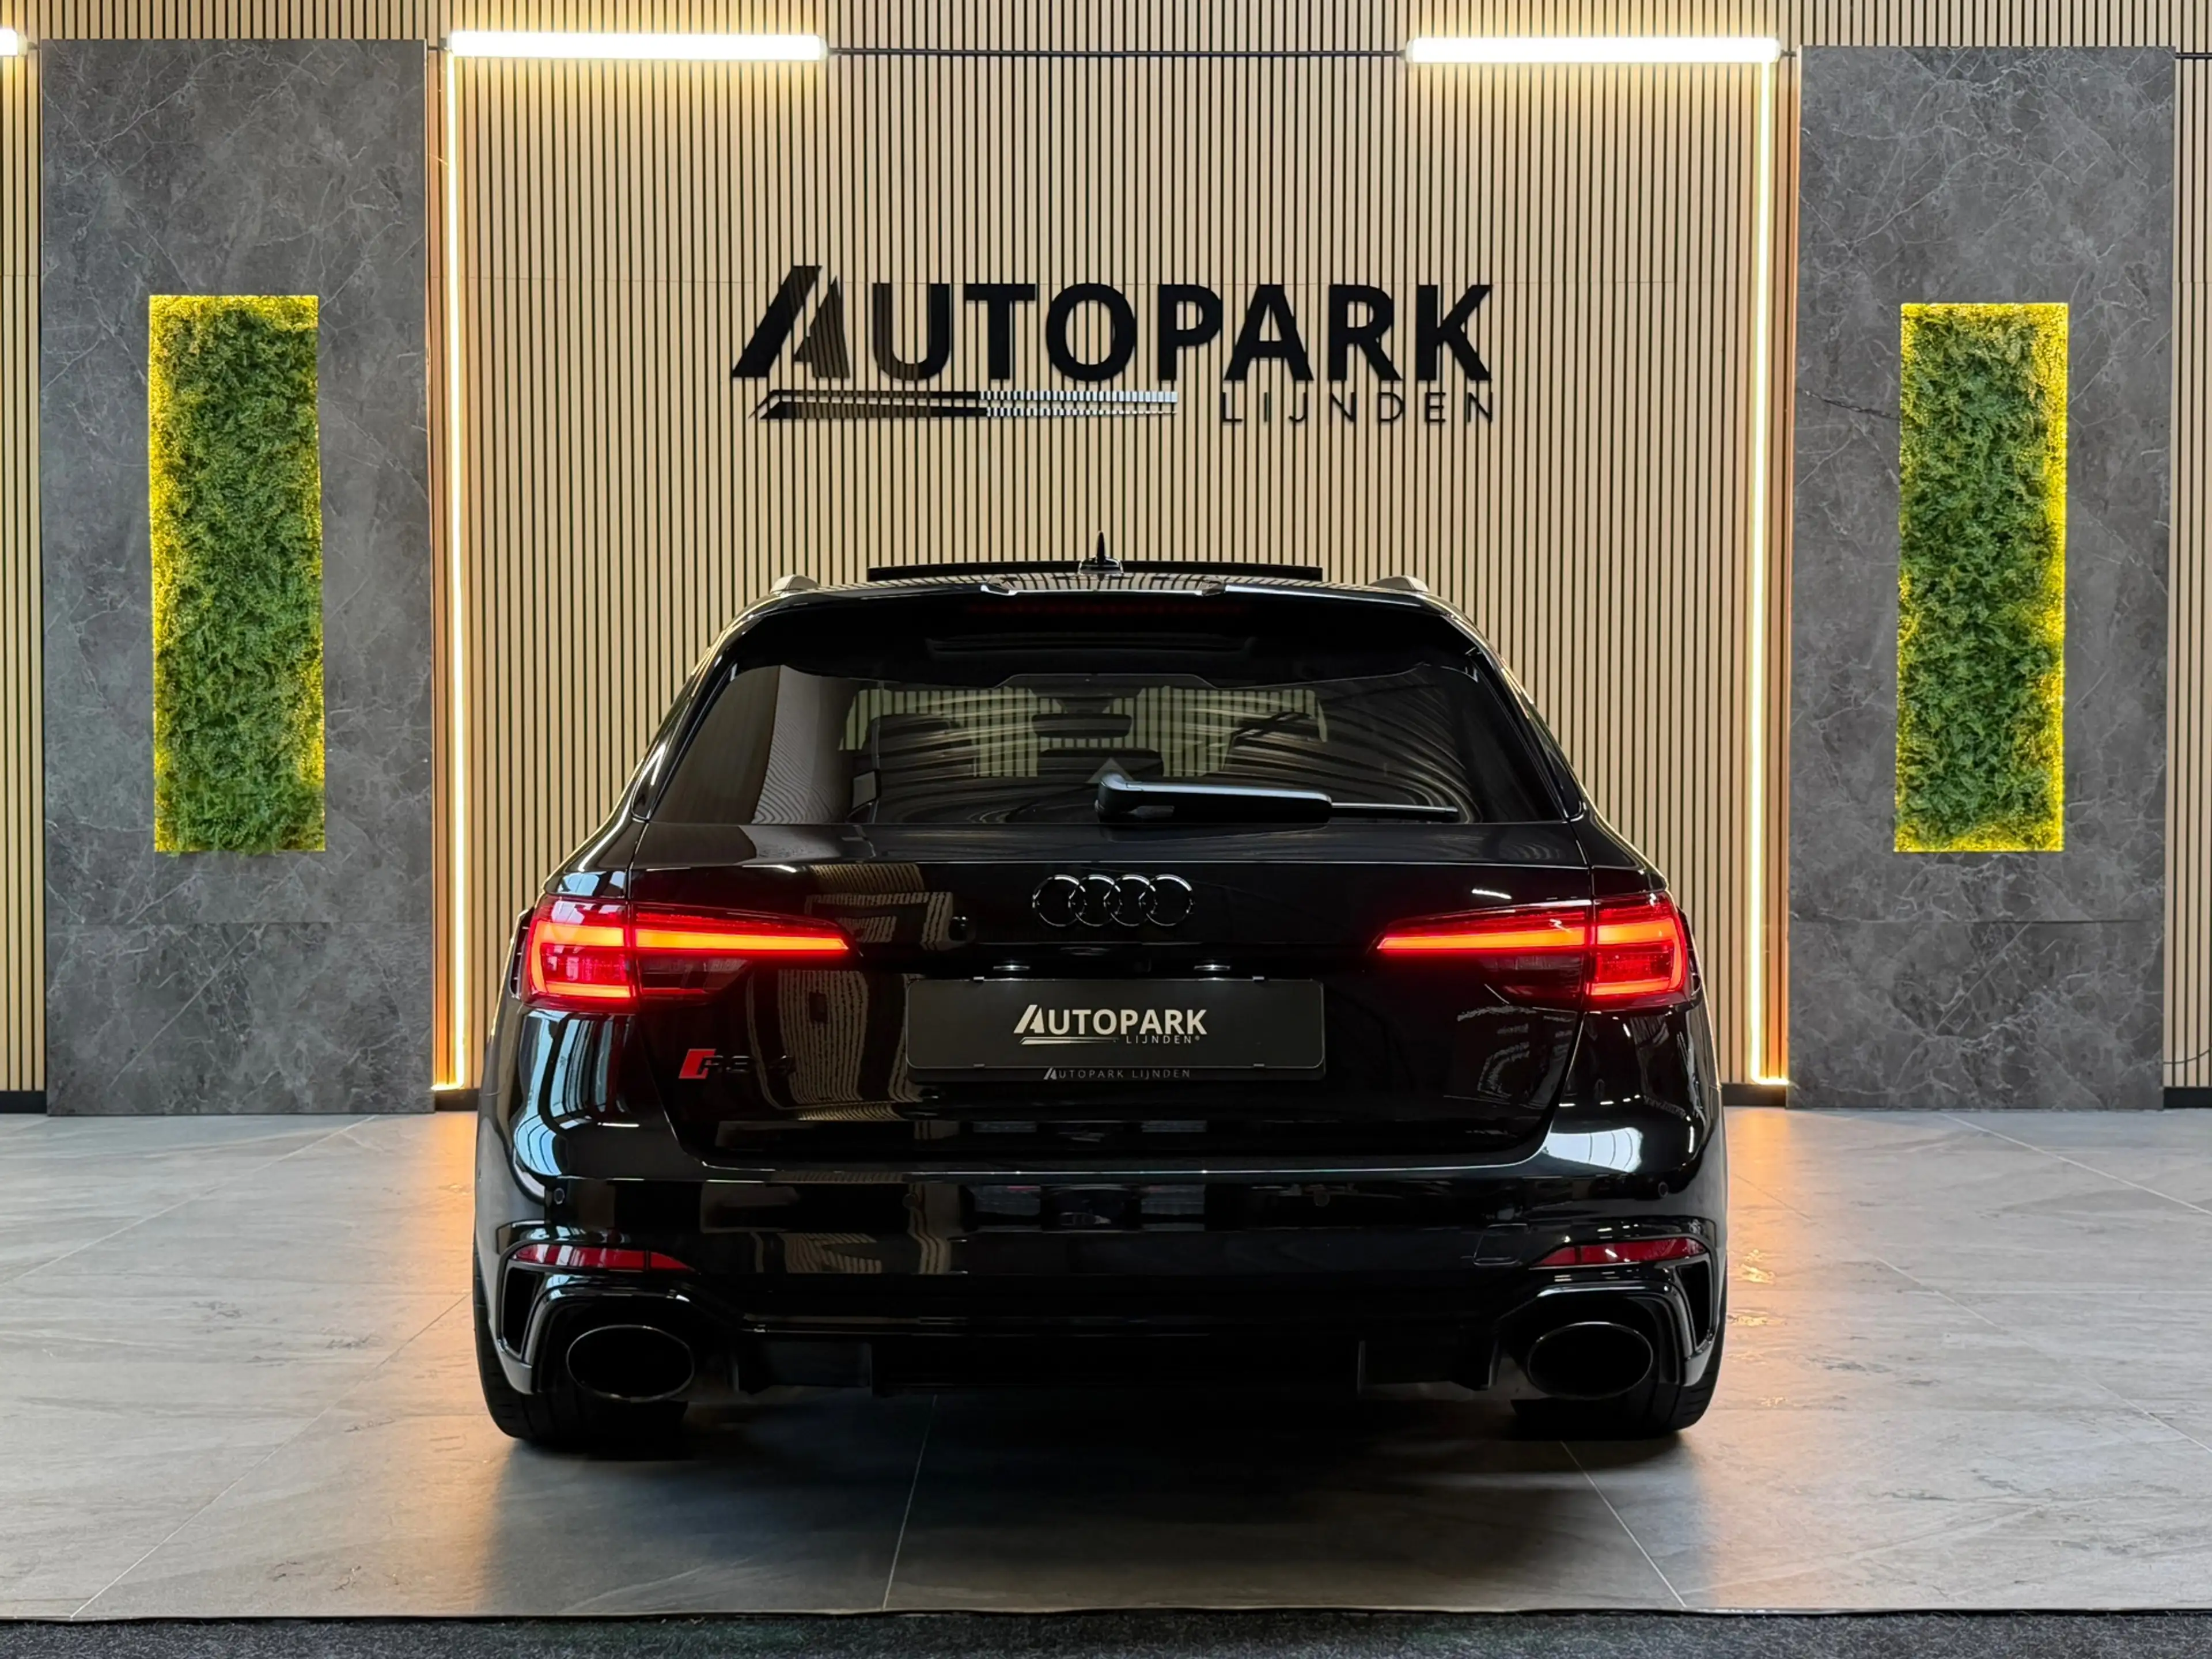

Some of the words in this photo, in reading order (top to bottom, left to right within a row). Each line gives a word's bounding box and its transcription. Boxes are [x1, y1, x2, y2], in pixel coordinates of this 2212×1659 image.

[731, 266, 1493, 381] AUTOPARK
[1221, 392, 1494, 423] LIJNDEN
[1013, 1005, 1207, 1035] AUTOPARK
[1044, 1067, 1124, 1079] AUTOPARK
[1132, 1069, 1191, 1080] LIJNDEN
